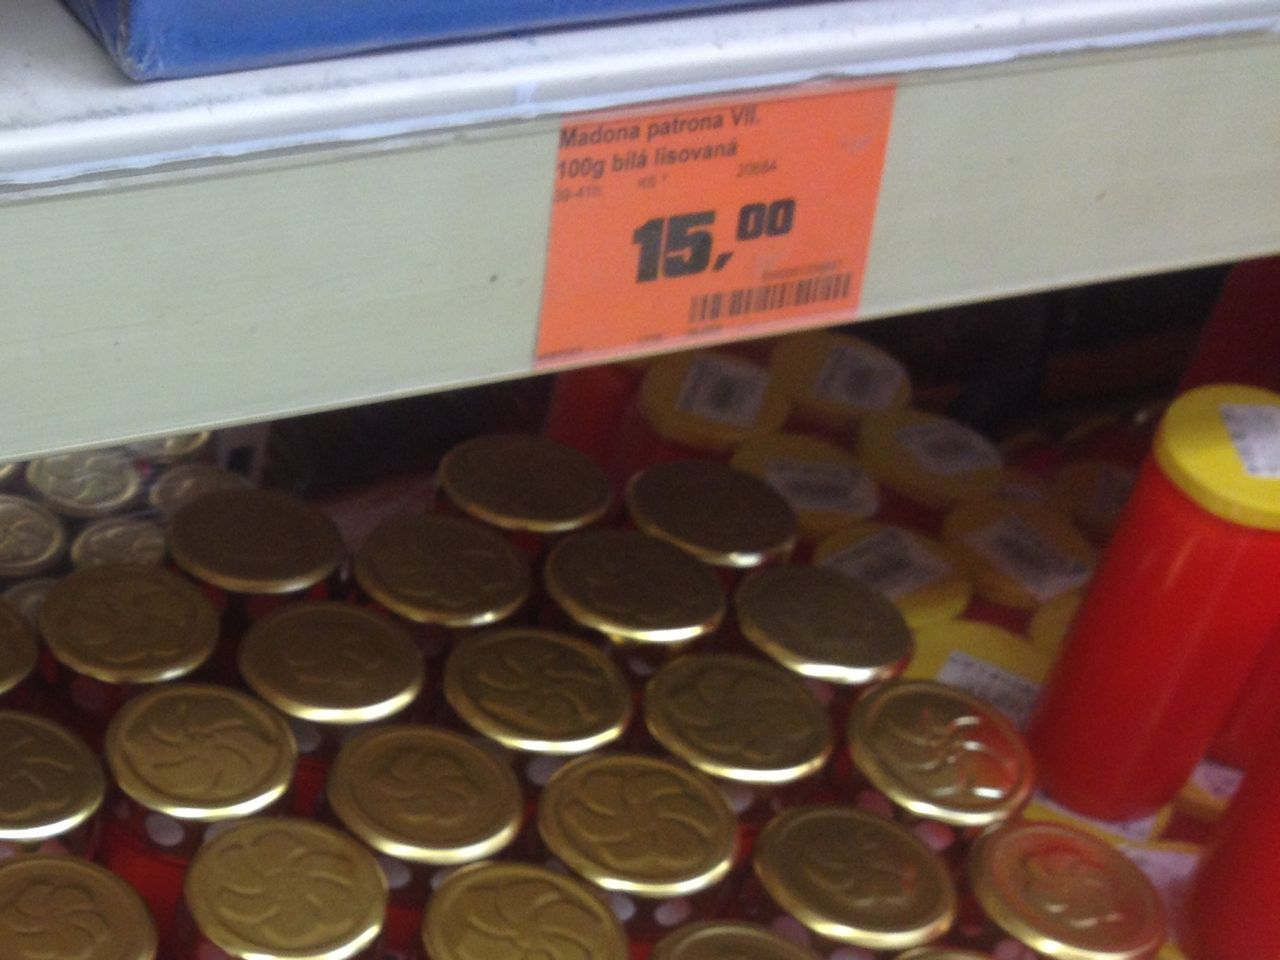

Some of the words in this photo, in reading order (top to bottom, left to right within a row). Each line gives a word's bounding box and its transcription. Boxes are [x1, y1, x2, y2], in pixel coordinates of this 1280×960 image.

[560, 126, 640, 149] Madona
[646, 113, 724, 142] patrona
[558, 157, 605, 180] 100g
[654, 137, 738, 164] lisovaná
